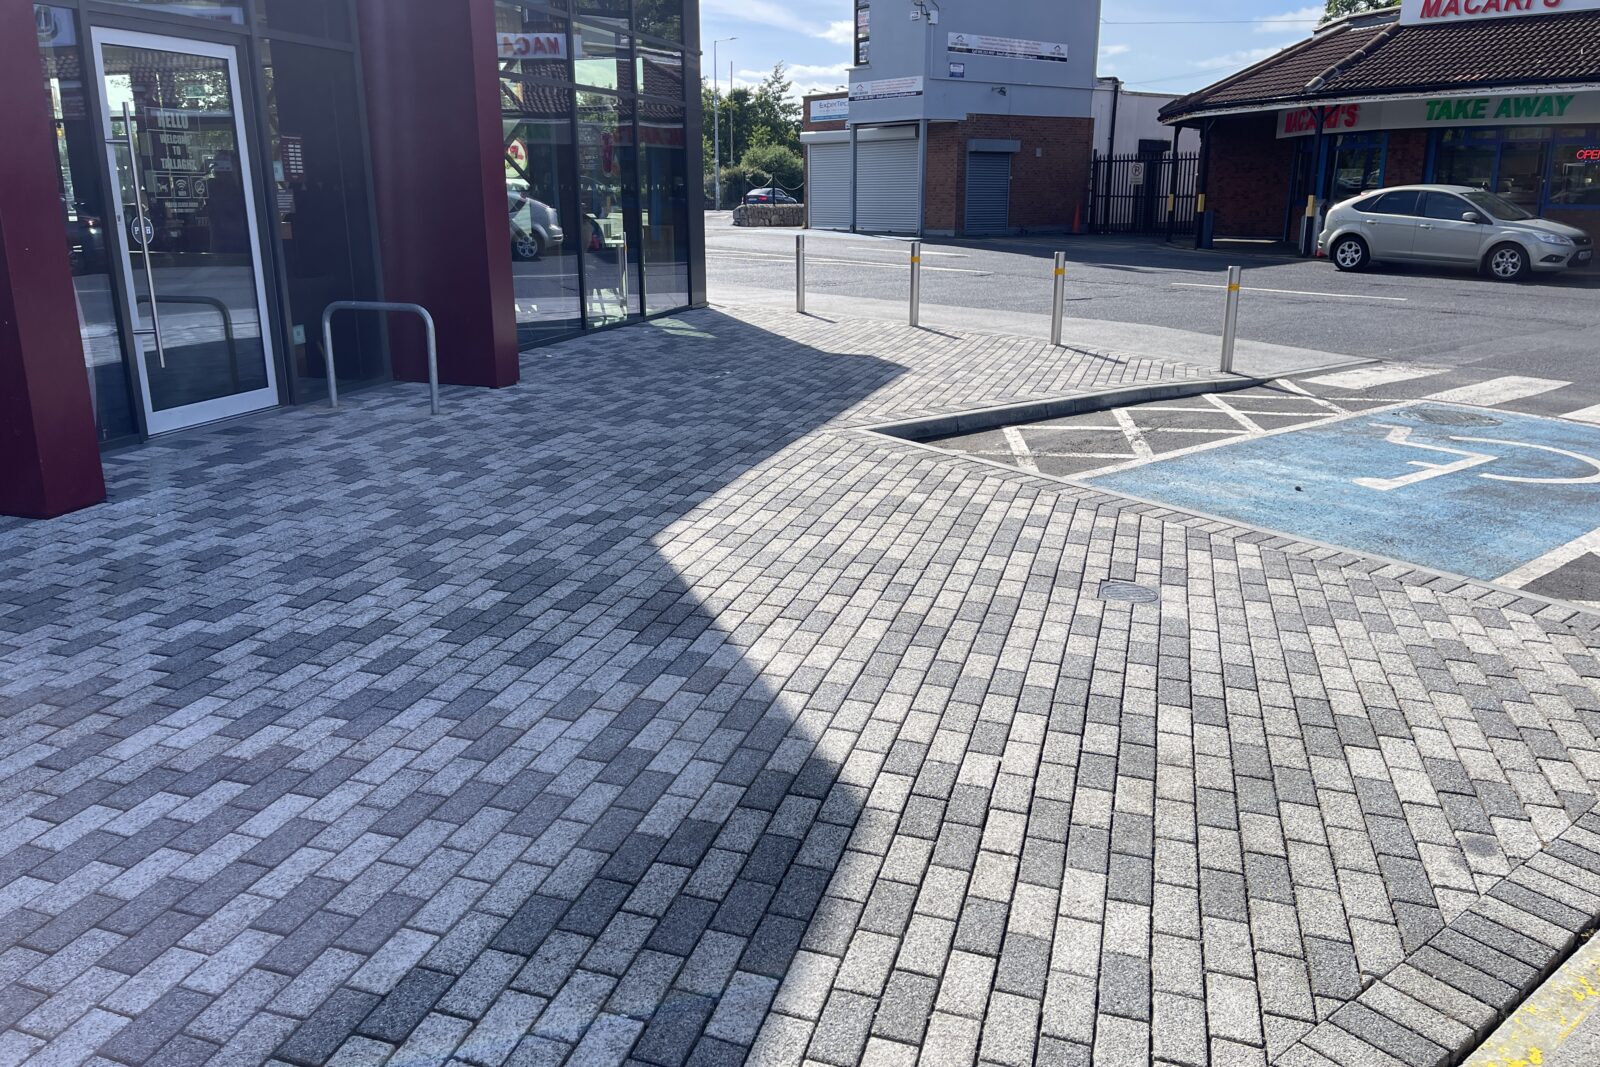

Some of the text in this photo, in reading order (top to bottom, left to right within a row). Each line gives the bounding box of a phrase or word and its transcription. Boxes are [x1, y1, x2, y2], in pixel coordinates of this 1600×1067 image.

[1420, 0, 1561, 18] MACAR
[1426, 95, 1575, 120] TAKE AWAY
[157, 112, 189, 129] HELLO
[160, 133, 192, 145] WELCOME
[172, 146, 181, 155] TO
[1577, 149, 1600, 160] OPE
